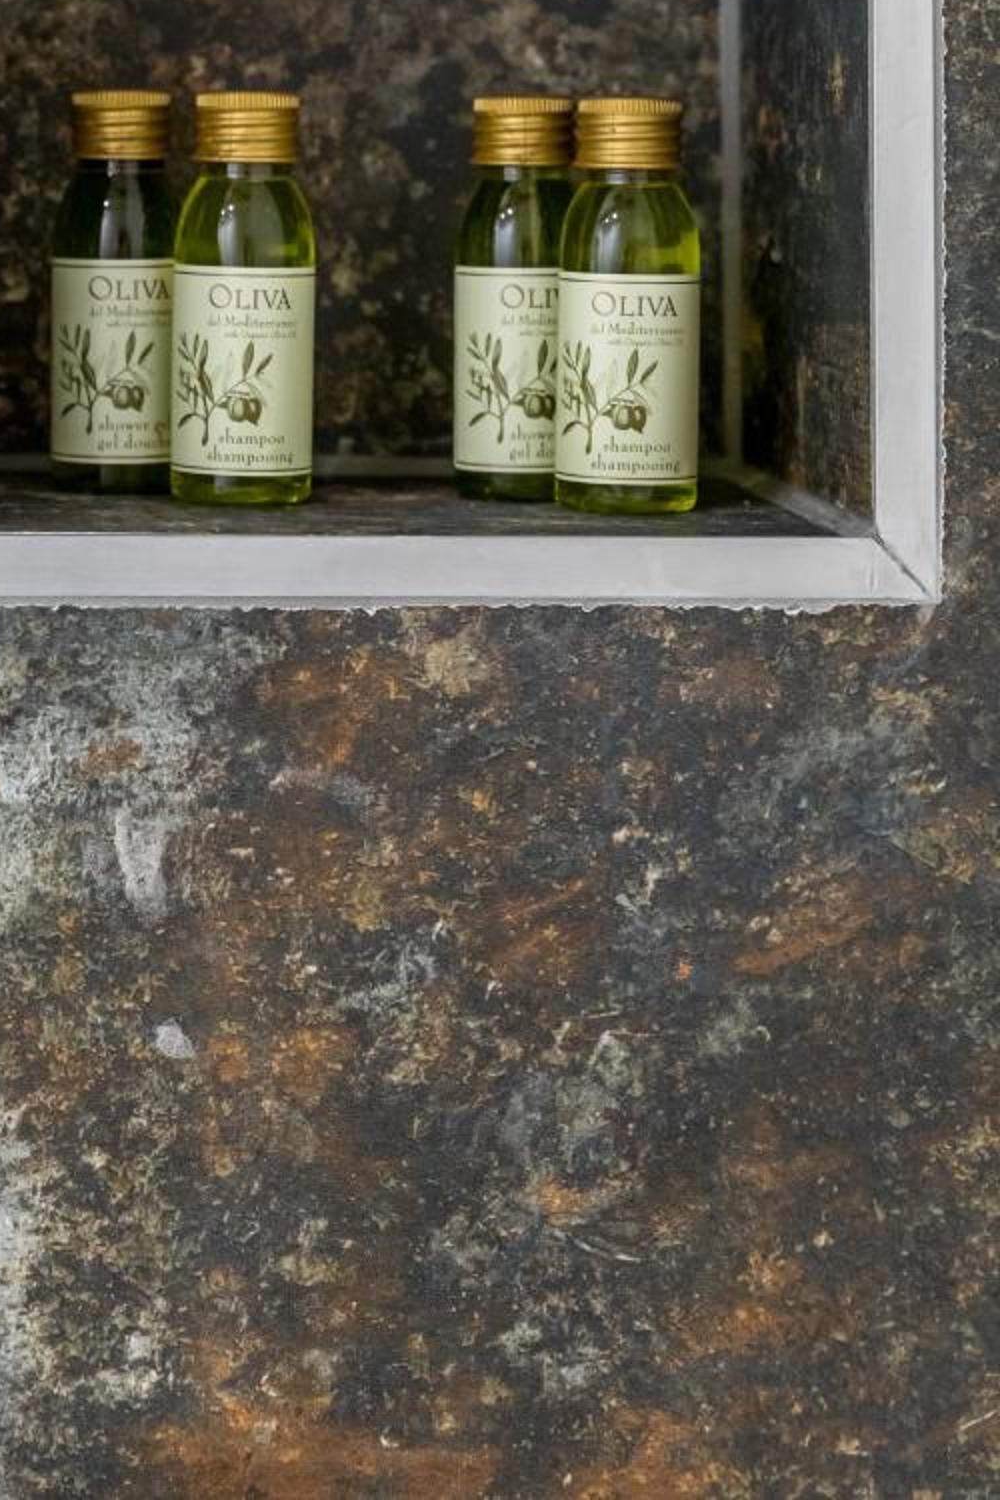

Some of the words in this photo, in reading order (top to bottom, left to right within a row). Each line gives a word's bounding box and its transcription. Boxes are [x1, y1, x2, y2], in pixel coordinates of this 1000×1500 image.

[88, 275, 169, 301] OLIVA
[209, 283, 292, 310] OLIVA
[592, 291, 679, 317] OLIVA
[219, 427, 285, 449] shampoo
[603, 436, 671, 457] shampoo
[591, 453, 680, 474] shampooing
